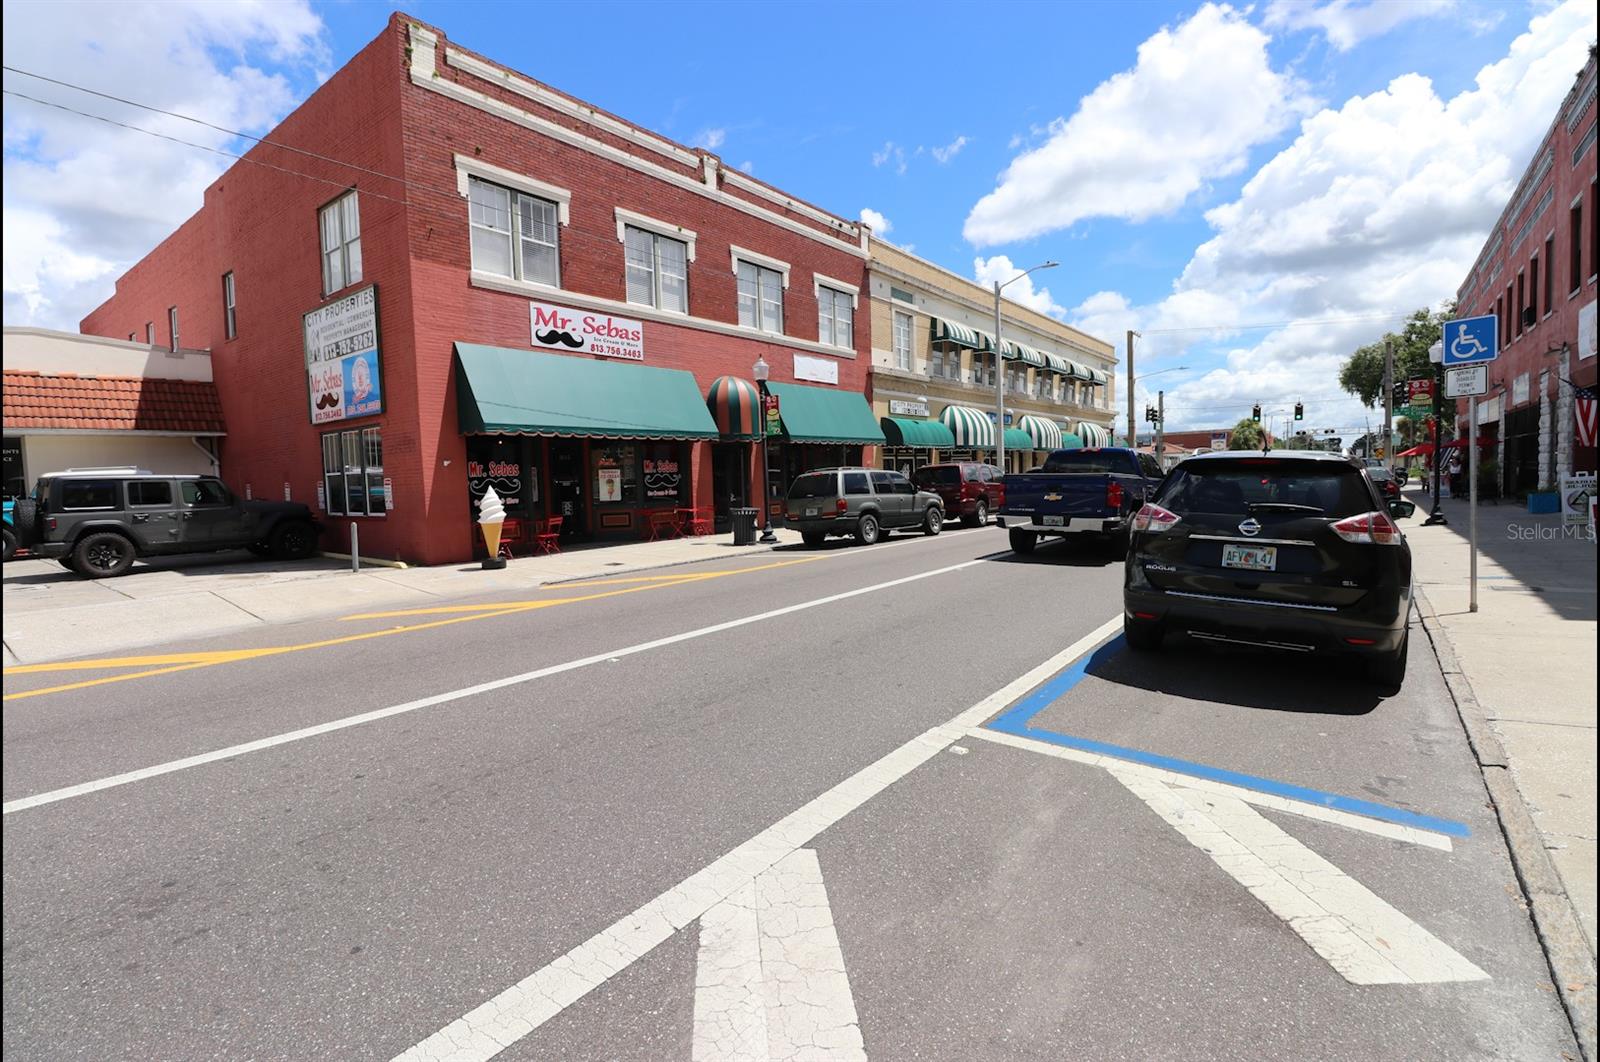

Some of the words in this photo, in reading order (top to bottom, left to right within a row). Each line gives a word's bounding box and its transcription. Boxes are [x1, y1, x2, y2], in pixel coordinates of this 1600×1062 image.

[306, 311, 322, 328] CITY
[325, 289, 374, 320] PROPERTIES
[343, 319, 372, 335] MANAGEMENT
[533, 306, 577, 332] Mr.
[582, 316, 641, 341] Sebas
[590, 343, 641, 358] 813.756.3463
[468, 461, 488, 477] Mr.
[489, 461, 520, 477] Sebas
[643, 459, 656, 474] Mr.
[656, 459, 679, 473] Sebas
